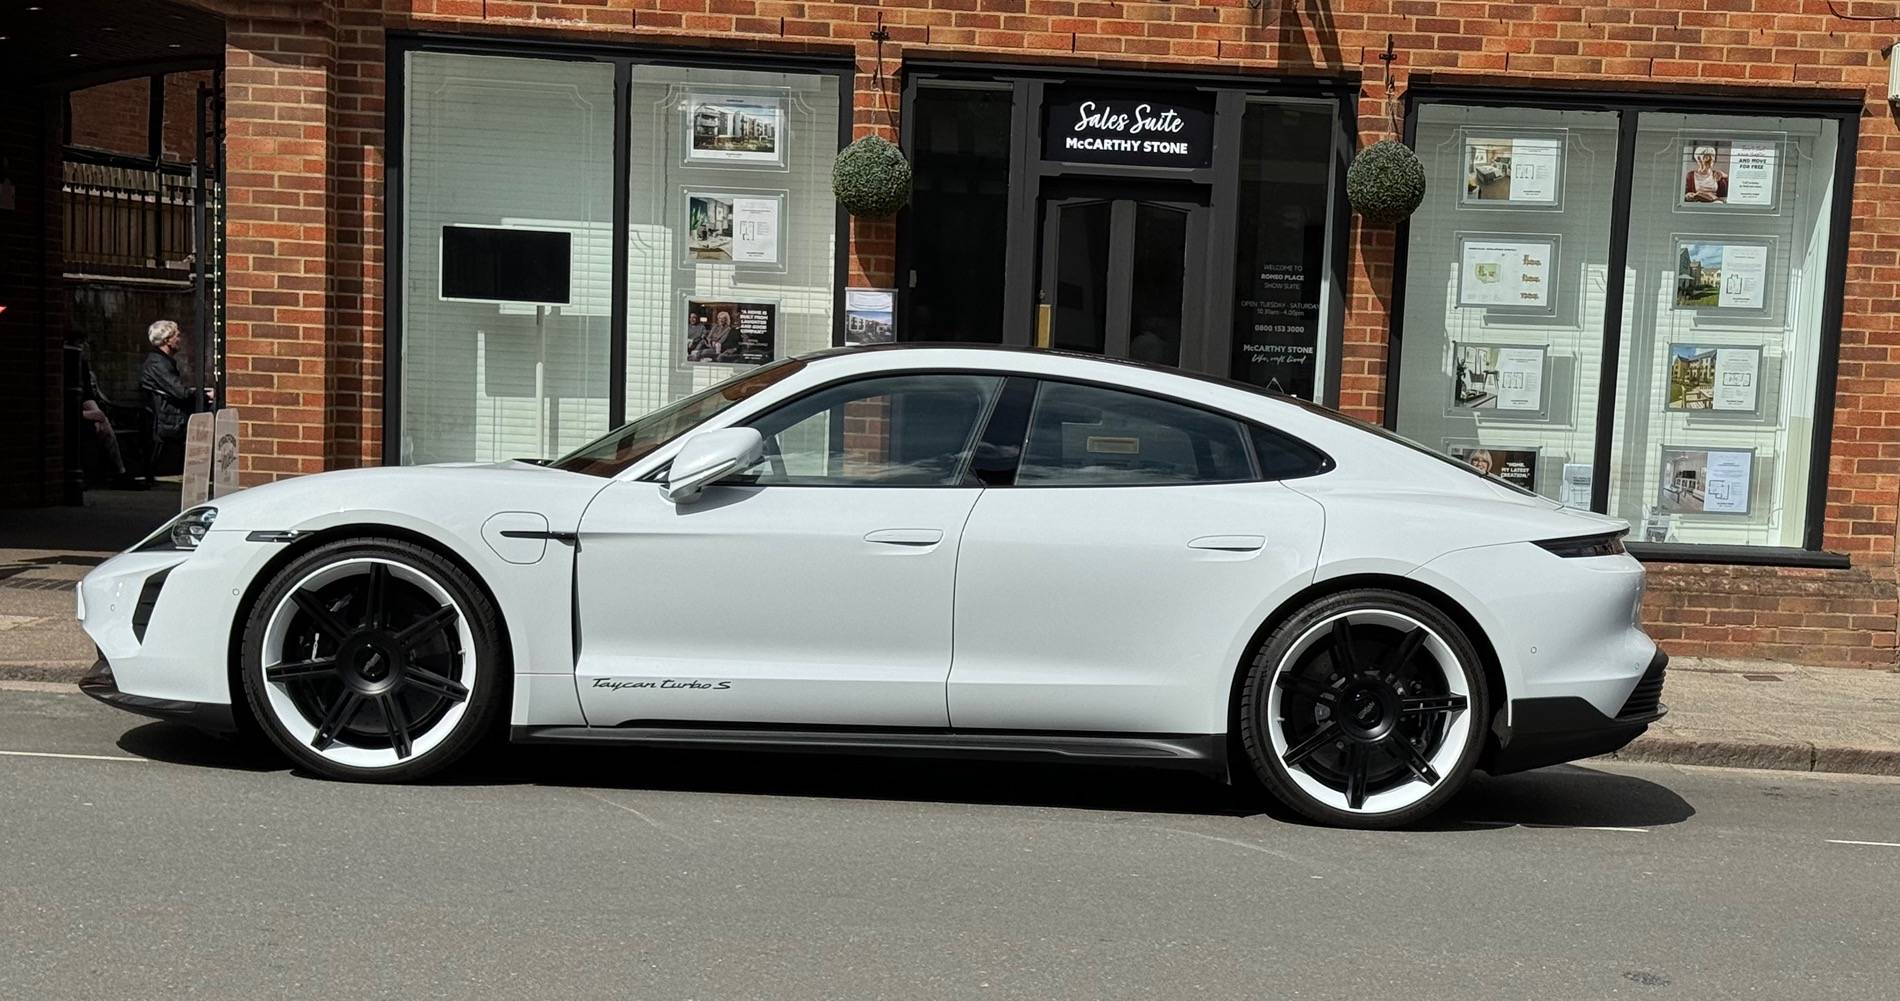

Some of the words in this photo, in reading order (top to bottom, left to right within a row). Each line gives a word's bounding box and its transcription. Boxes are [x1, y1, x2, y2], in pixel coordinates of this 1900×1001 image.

[1074, 101, 1129, 131] Sales
[1130, 104, 1184, 134] Suite
[1065, 137, 1141, 152] McCARTHY
[1143, 142, 1188, 154] STONE
[1289, 302, 1320, 310] SATURDAY
[1254, 324, 1273, 332] 0800
[1287, 325, 1304, 333] 3000
[1243, 343, 1286, 353] McCARTHY
[1287, 346, 1314, 354] STONE
[592, 678, 656, 691] Taycan
[713, 681, 731, 689] S
